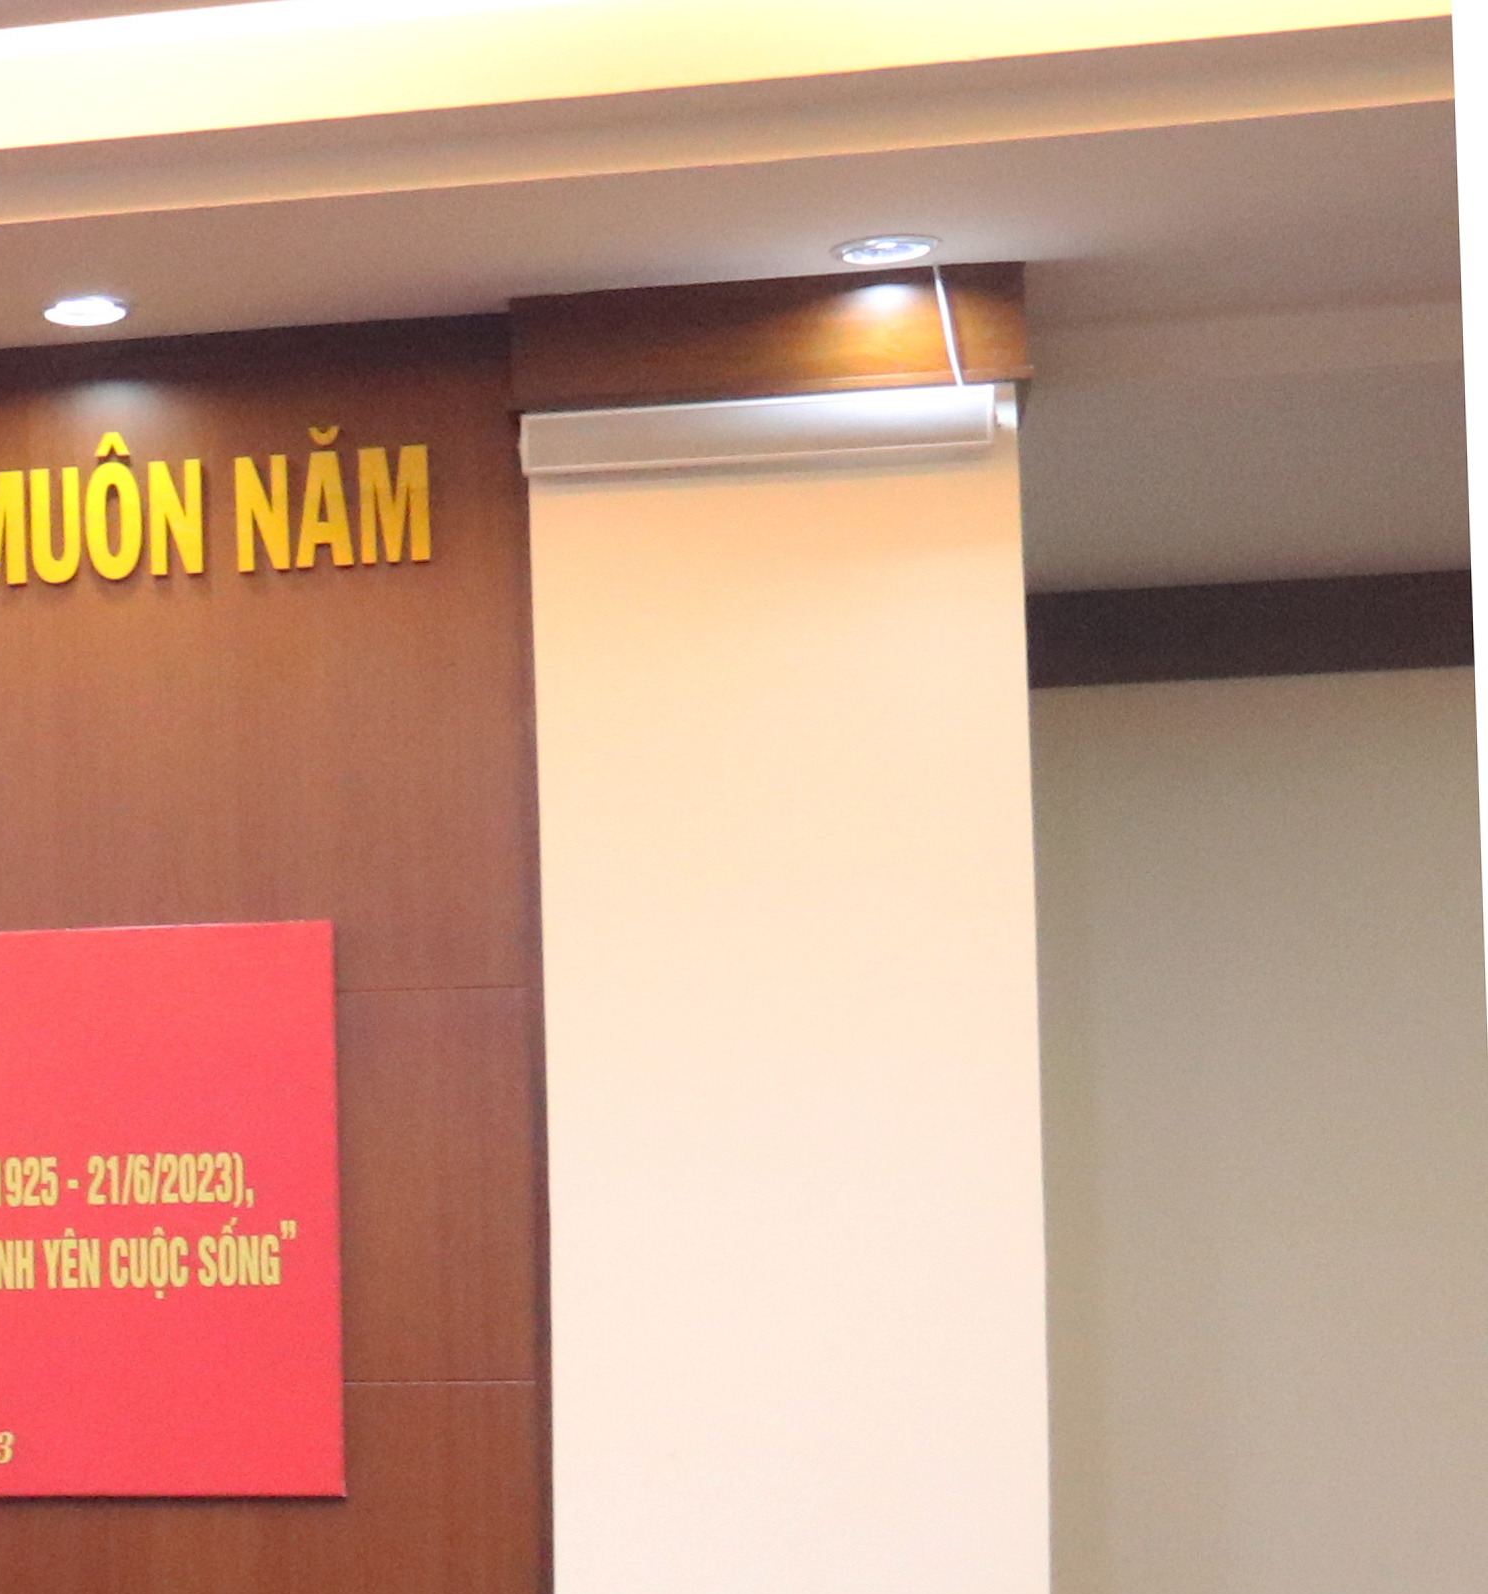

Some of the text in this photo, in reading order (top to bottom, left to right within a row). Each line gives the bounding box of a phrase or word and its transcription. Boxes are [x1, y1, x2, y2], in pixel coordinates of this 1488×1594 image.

[234, 425, 431, 574] NĂM
[87, 1151, 255, 1208] 21/6/2023),
[42, 1227, 100, 1290] YÊN
[109, 1226, 189, 1299] CUỘC
